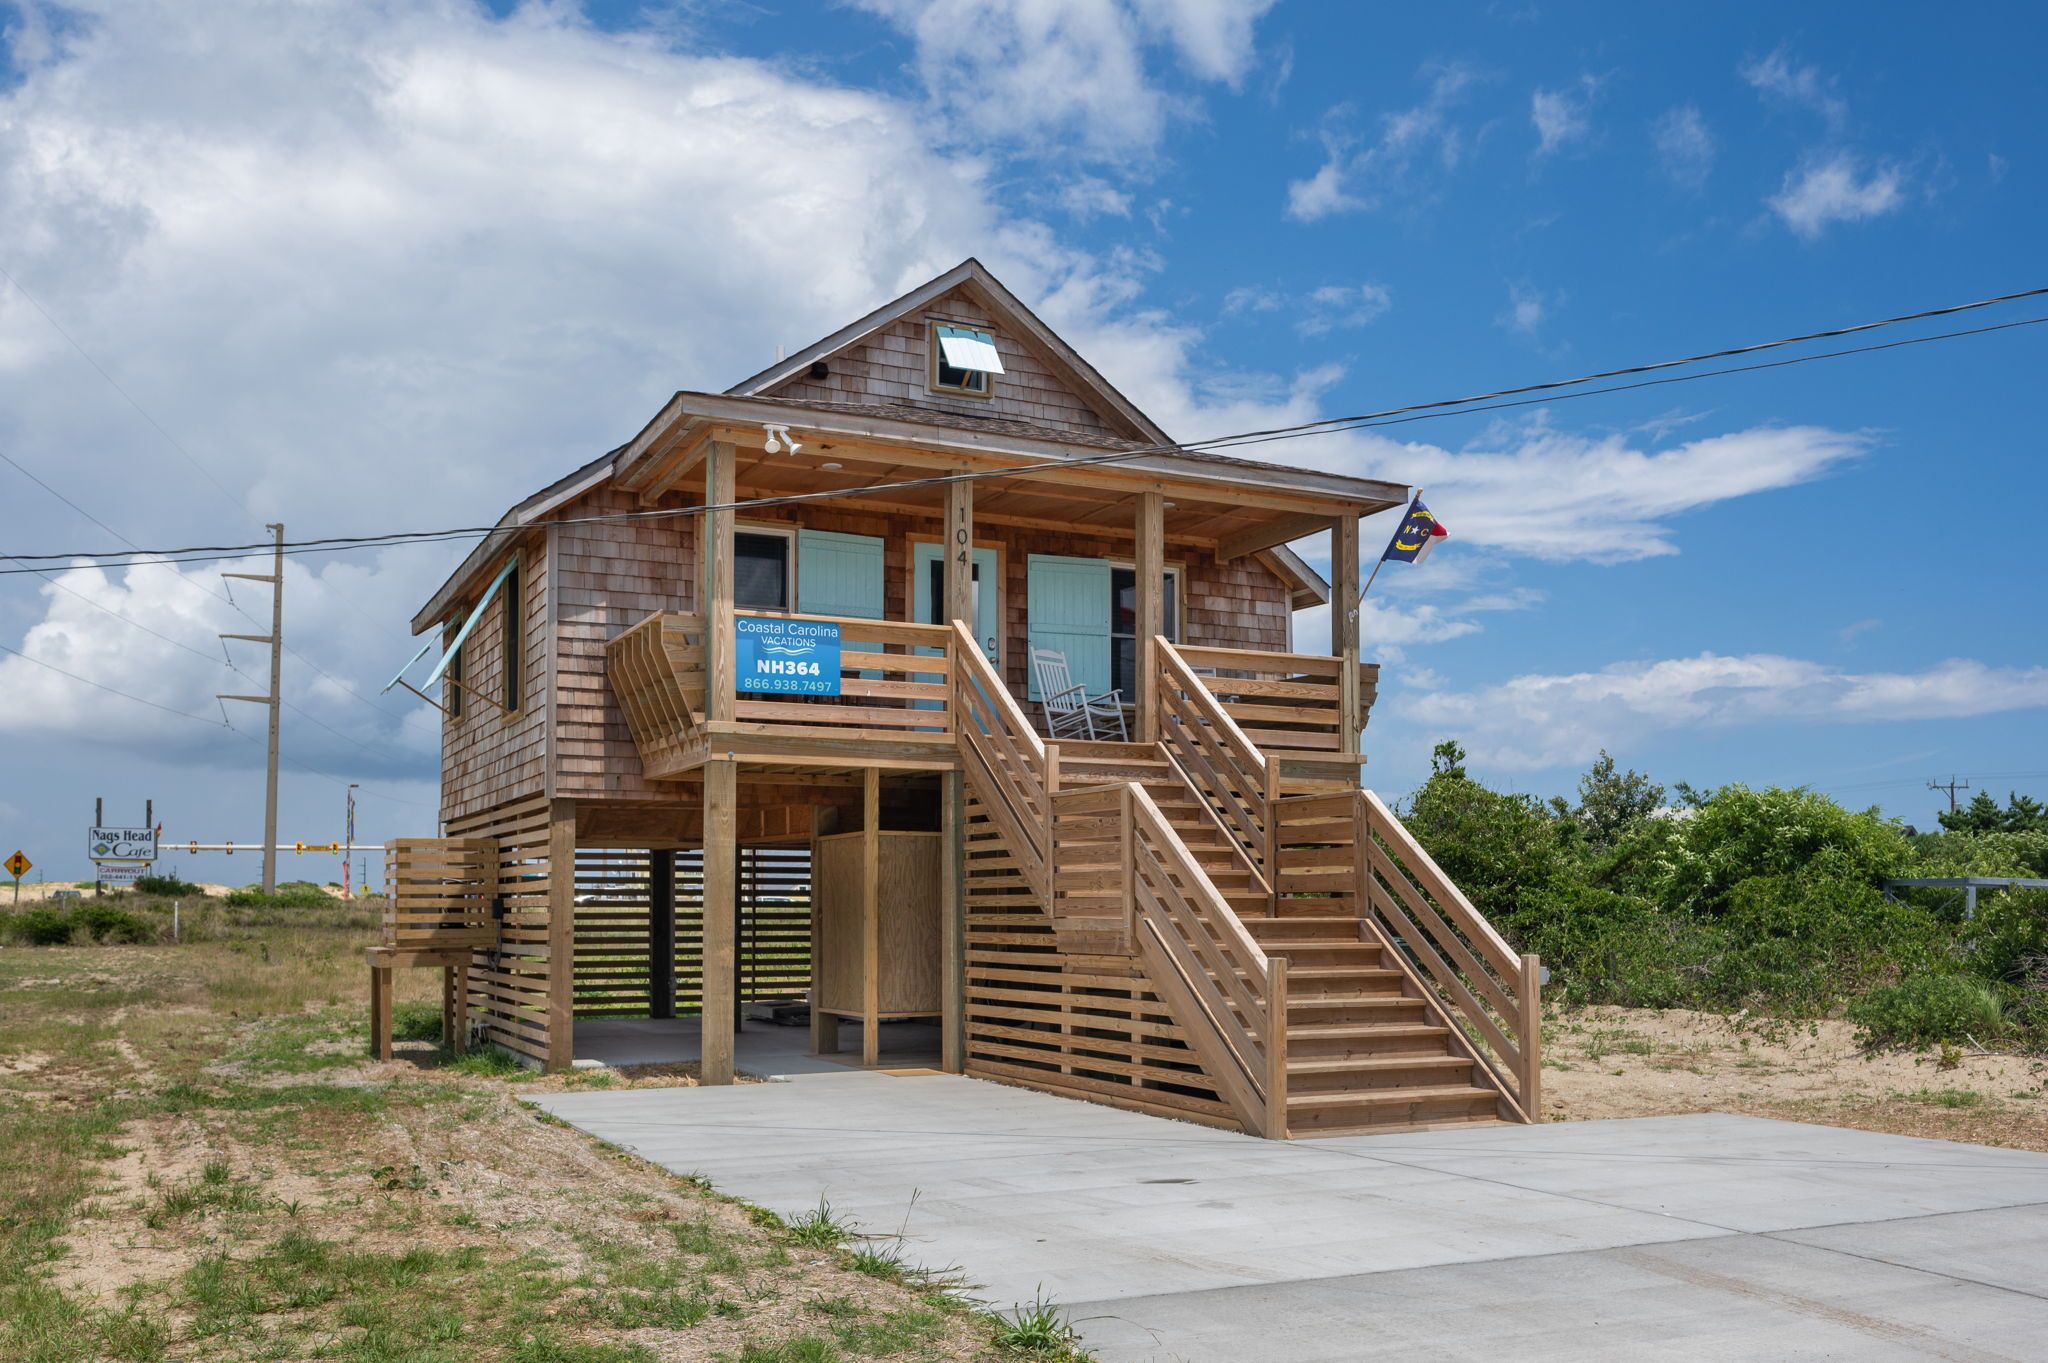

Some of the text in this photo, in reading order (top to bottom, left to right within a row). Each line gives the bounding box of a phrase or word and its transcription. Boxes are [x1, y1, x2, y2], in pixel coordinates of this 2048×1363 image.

[956, 507, 968, 566] 104
[1420, 528, 1429, 537] C
[737, 620, 838, 638] Coastal Carolina
[761, 636, 816, 647] VACATIONS
[757, 659, 820, 676] NH364
[744, 678, 832, 692] 866.938.7497
[92, 829, 152, 844] Nags Head
[112, 842, 152, 858] Cafe
